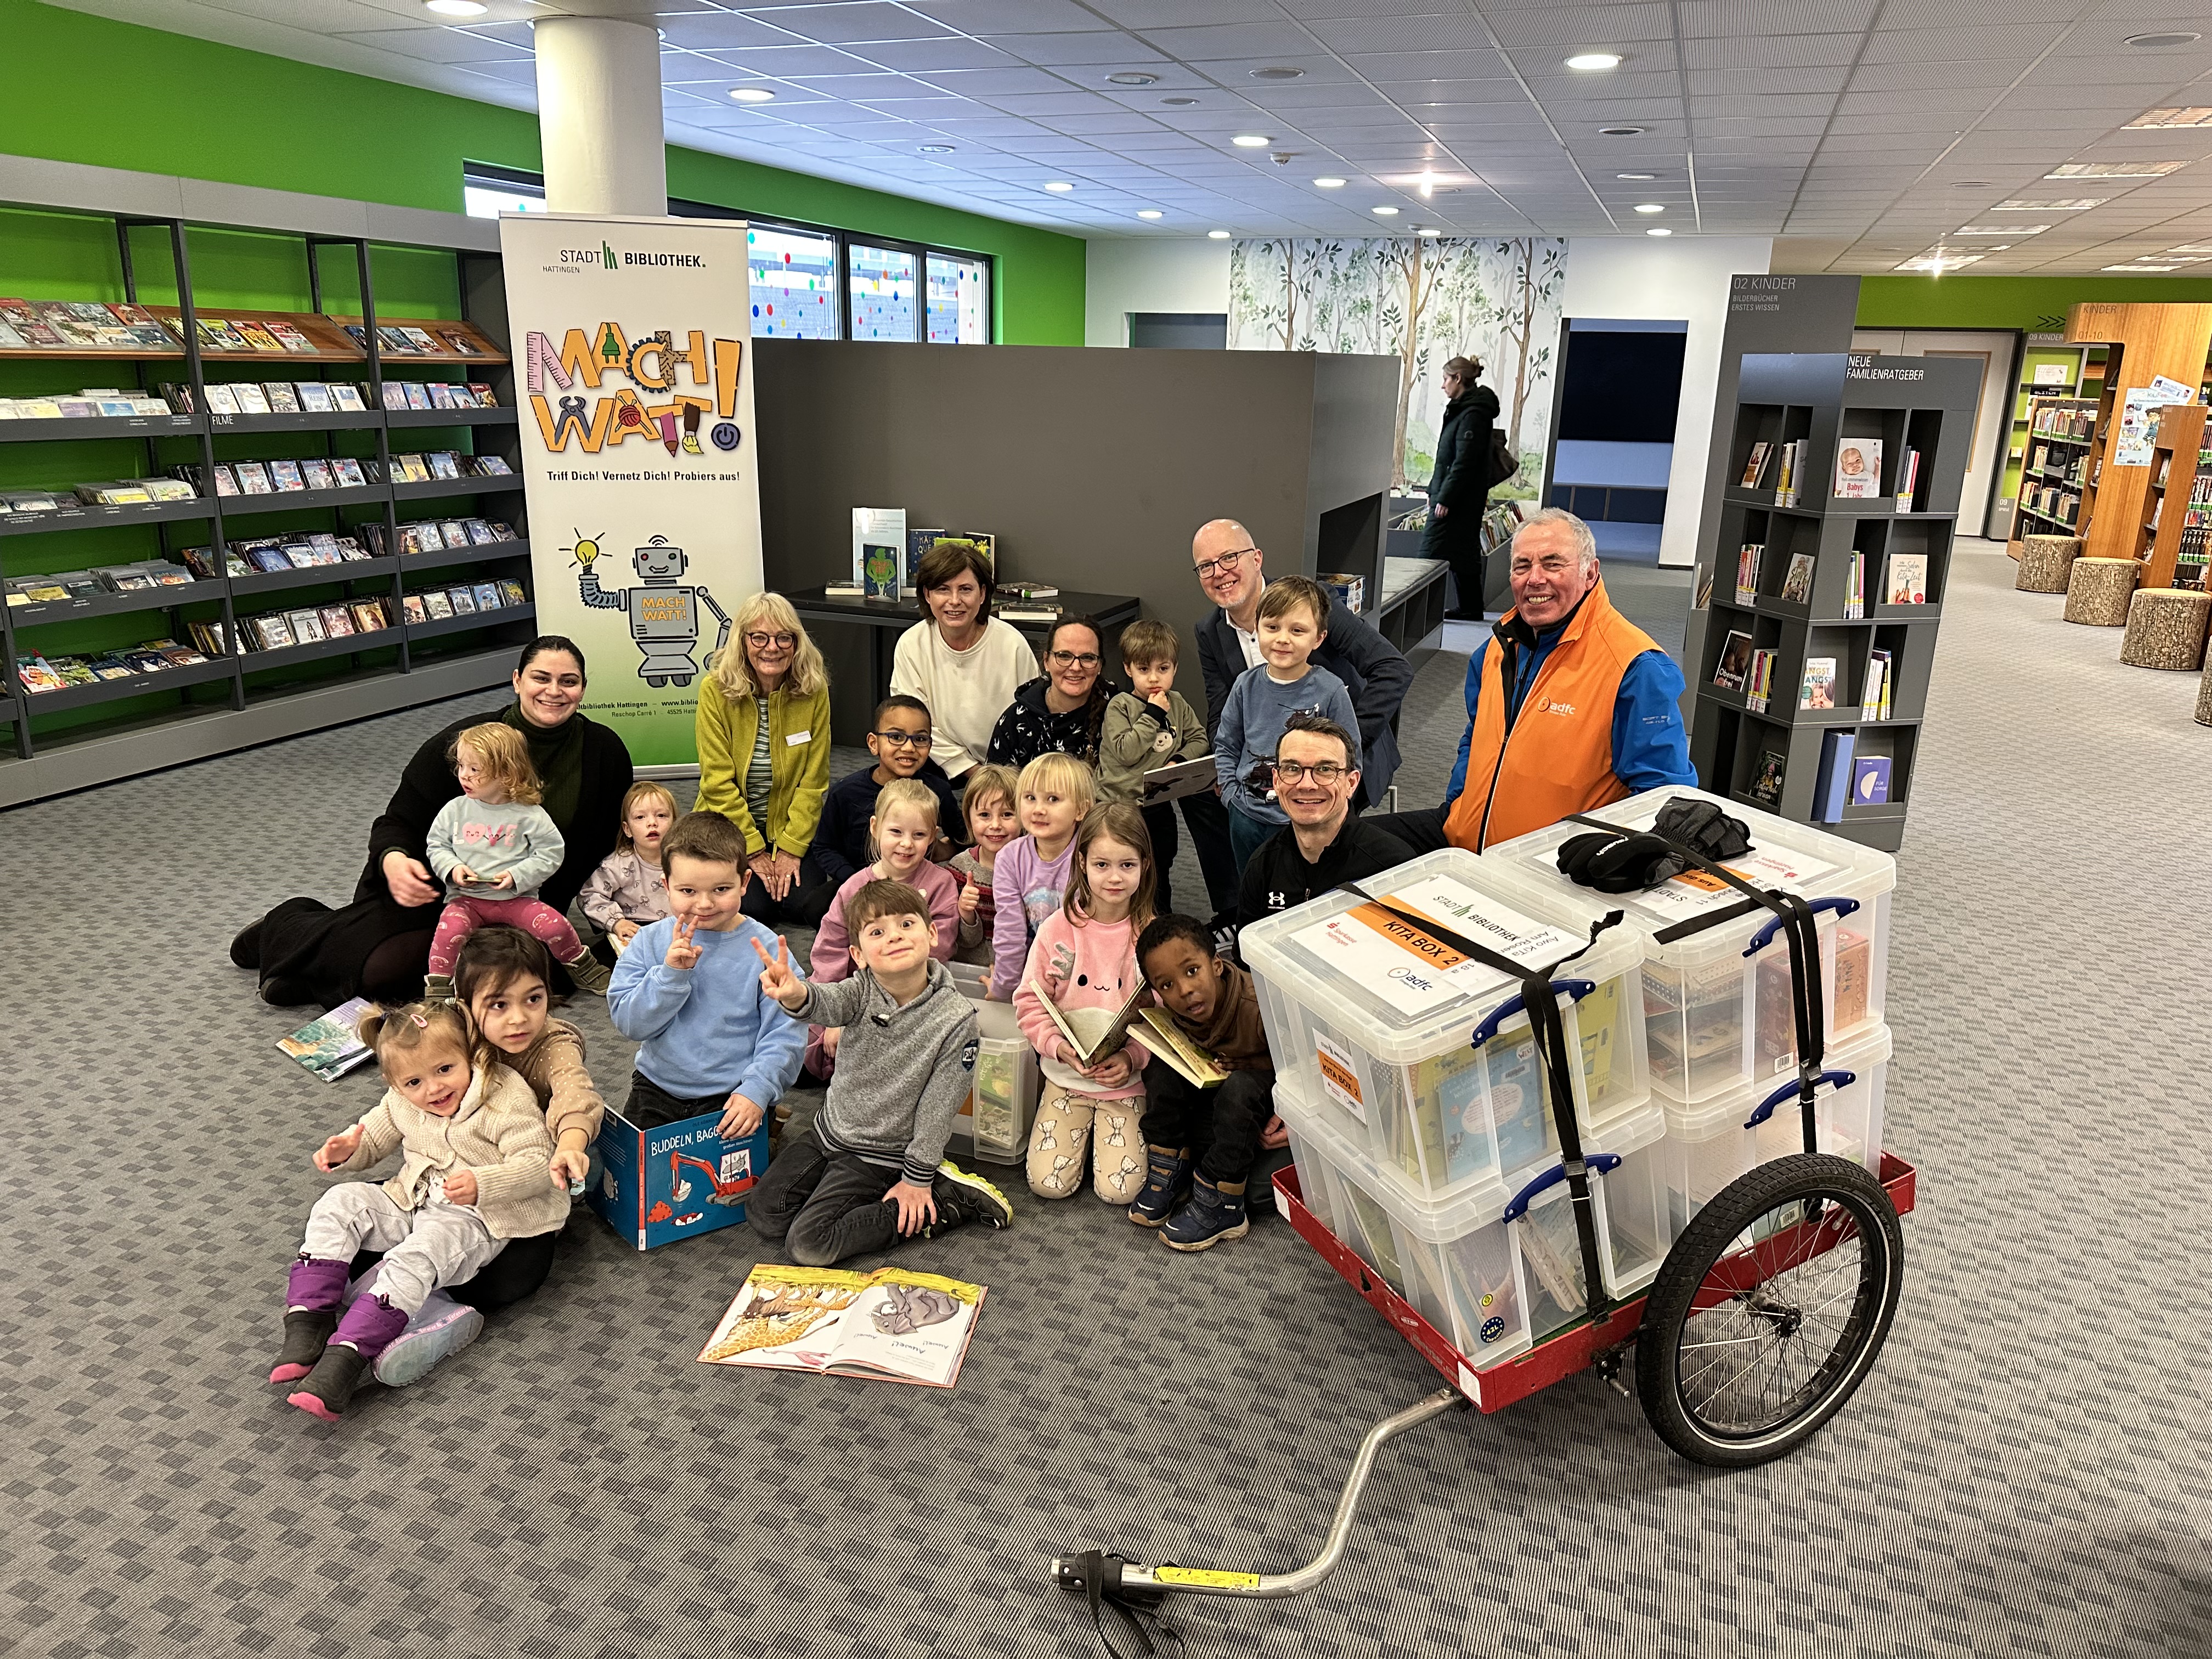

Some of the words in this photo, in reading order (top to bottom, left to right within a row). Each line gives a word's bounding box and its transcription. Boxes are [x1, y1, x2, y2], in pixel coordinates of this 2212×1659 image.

[560, 250, 602, 263] STADT
[624, 252, 706, 268] BIBLIOTHEK.
[1734, 278, 1748, 289] 02
[1751, 277, 1796, 290] KINDER
[1733, 294, 1778, 302] BILDERBÜCHER
[2083, 305, 2117, 314] KINDER
[2039, 333, 2063, 341] KINDER
[2078, 331, 2103, 340] 01-10
[527, 322, 709, 393] MACH
[1848, 356, 1871, 367] NEUE
[1846, 368, 1925, 381] FAMILIENRATGEBER
[212, 415, 234, 426] FILME
[547, 471, 568, 481] Triff
[571, 471, 599, 481] Dich!
[602, 471, 641, 481] Vernetz
[644, 471, 670, 481] Dich!
[674, 471, 716, 481] Probiers
[719, 471, 740, 481] aus!
[1847, 483, 1864, 492] Babys
[919, 535, 936, 545] KÄFE
[641, 597, 686, 608] MACH
[641, 610, 687, 621] WATT!
[1719, 667, 1743, 683] Obenrum
[1550, 702, 1576, 715] adfc
[453, 821, 518, 847] LOVE
[1432, 895, 1462, 913] STADT
[1468, 913, 1521, 941] BIBLIOTHEK
[1383, 920, 1413, 942] KITA
[1410, 936, 1445, 958] BOX
[1442, 955, 1459, 966] 2
[1404, 973, 1434, 992] adfc
[1322, 1063, 1338, 1080] KITA
[1338, 1074, 1352, 1092] BOX
[651, 1131, 695, 1156] BUDDELN,
[1486, 1324, 1499, 1335] 42L
